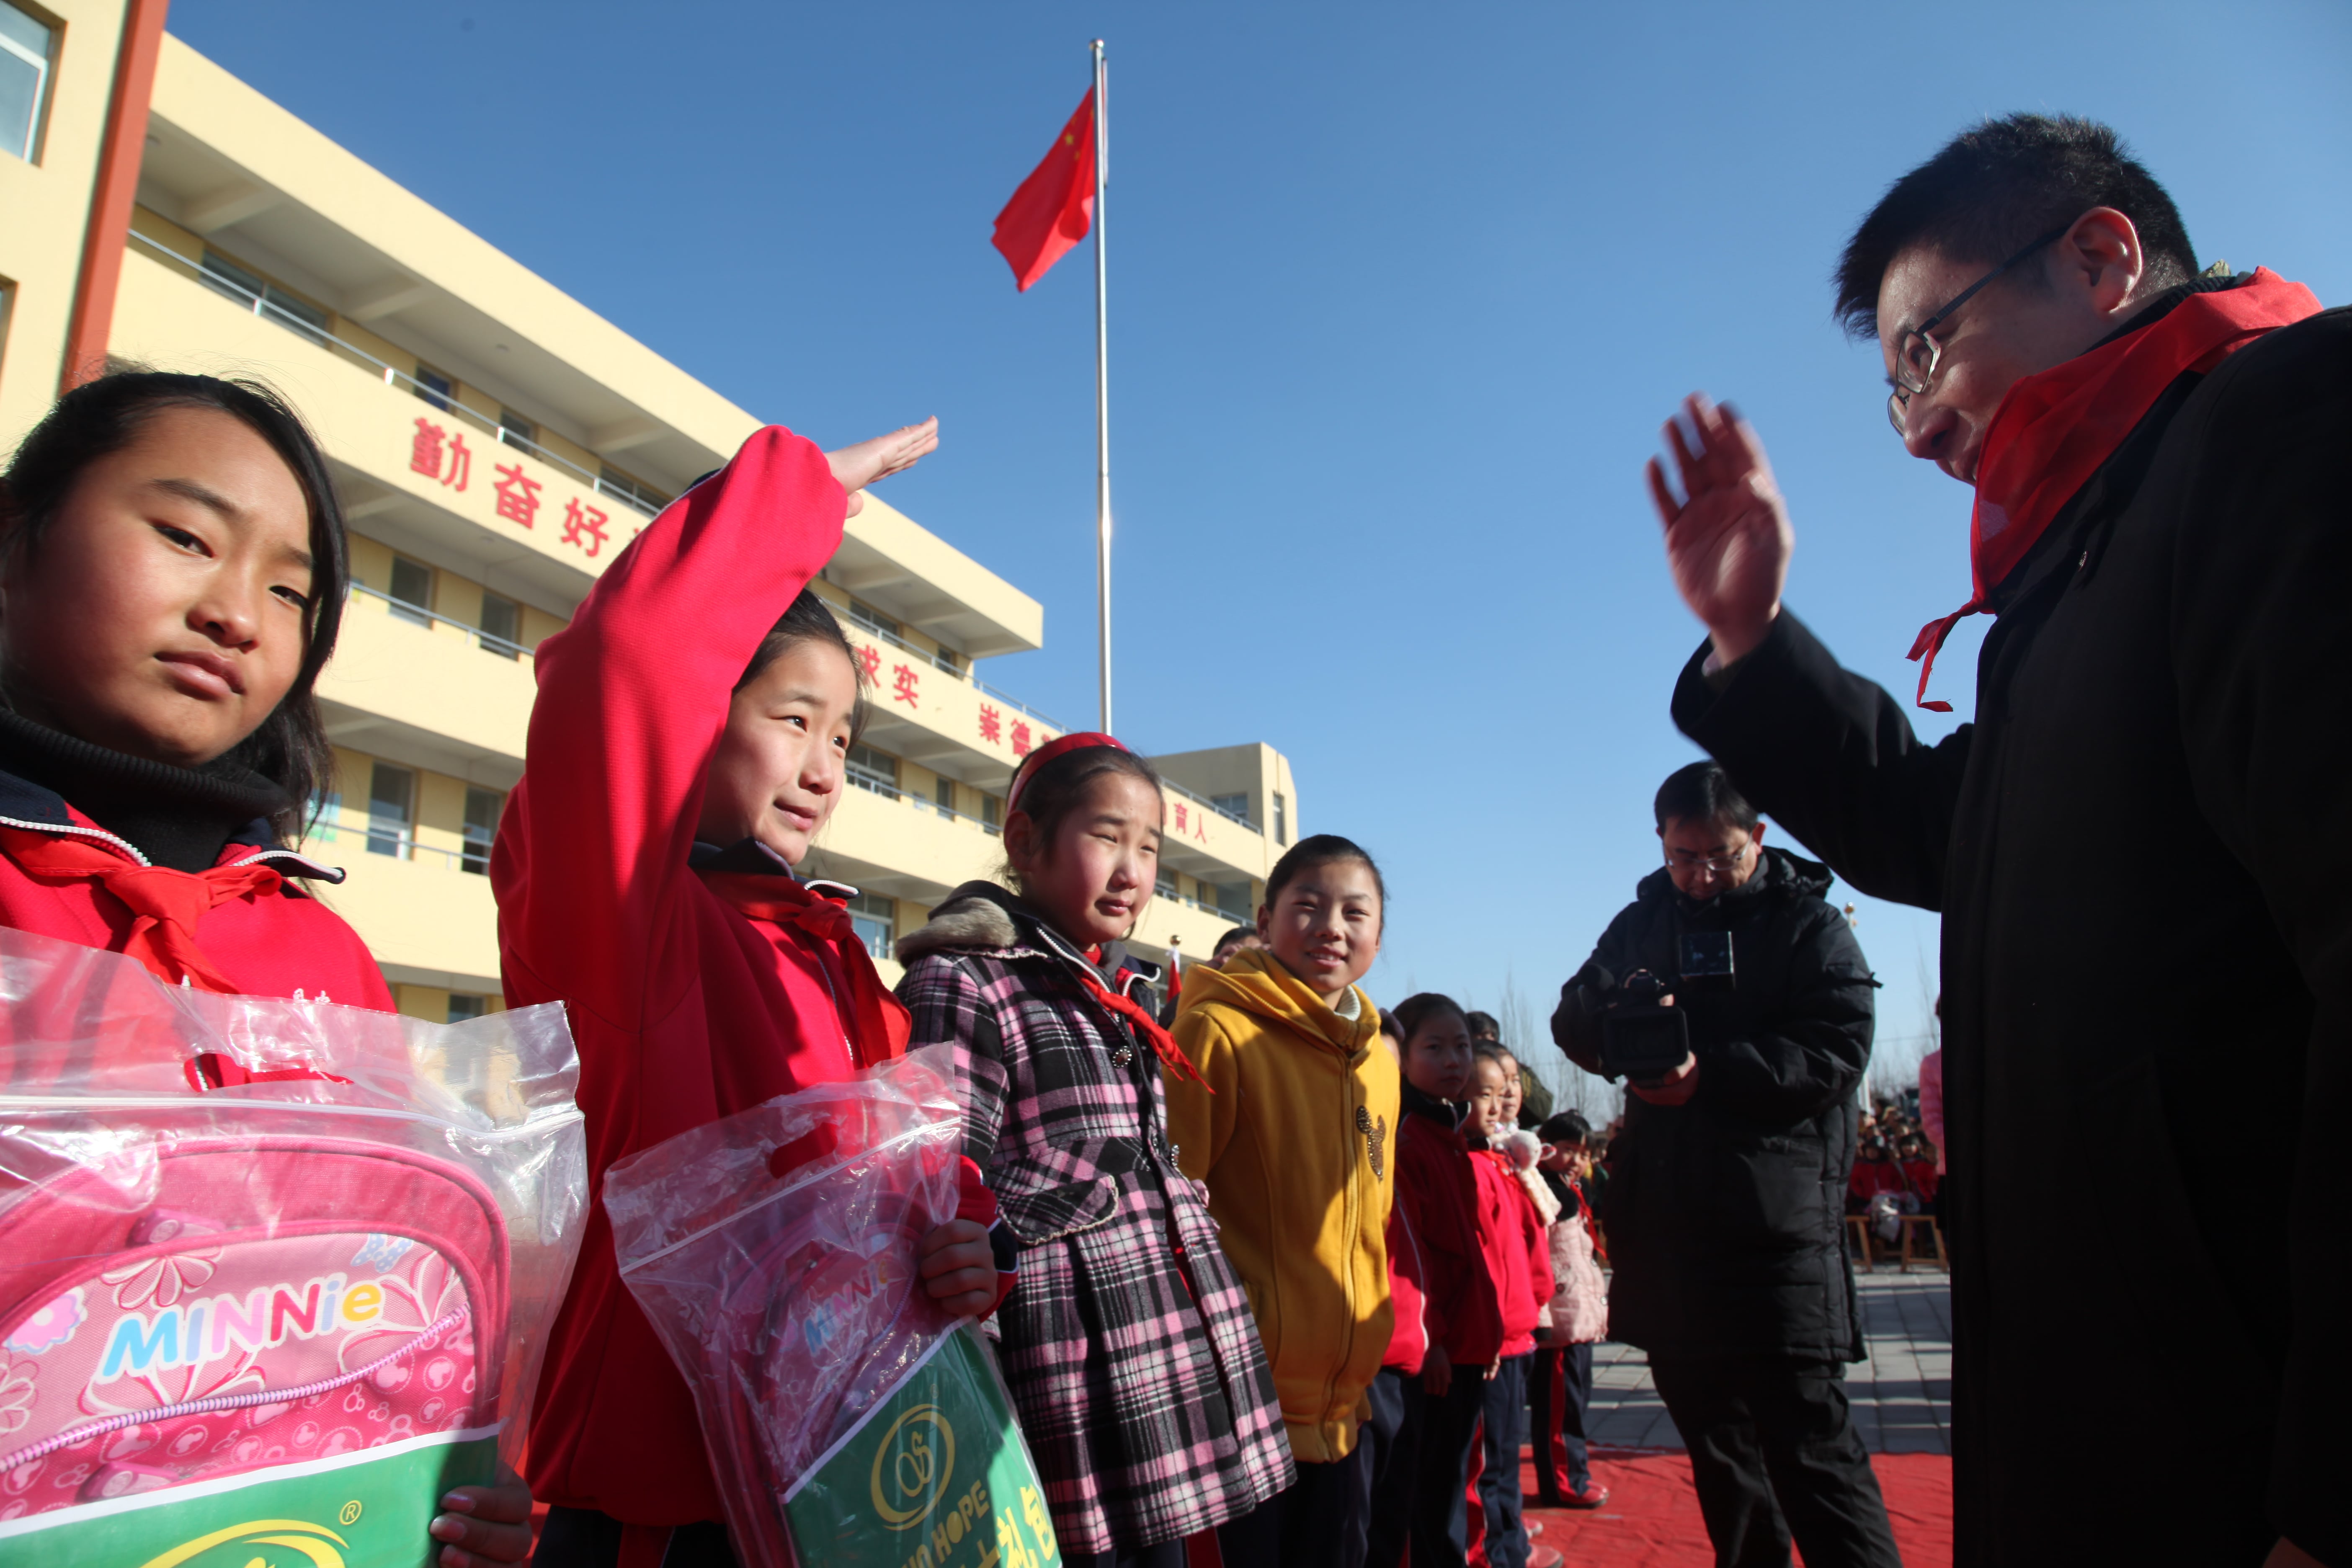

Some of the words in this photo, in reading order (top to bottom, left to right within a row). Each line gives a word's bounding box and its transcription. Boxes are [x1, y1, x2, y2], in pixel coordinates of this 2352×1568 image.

[410, 417, 642, 557] 勤奋好
[854, 644, 919, 709] 求实
[978, 701, 1050, 759] 崇德
[1162, 802, 1207, 844] 育人
[931, 1480, 990, 1563] HOPE
